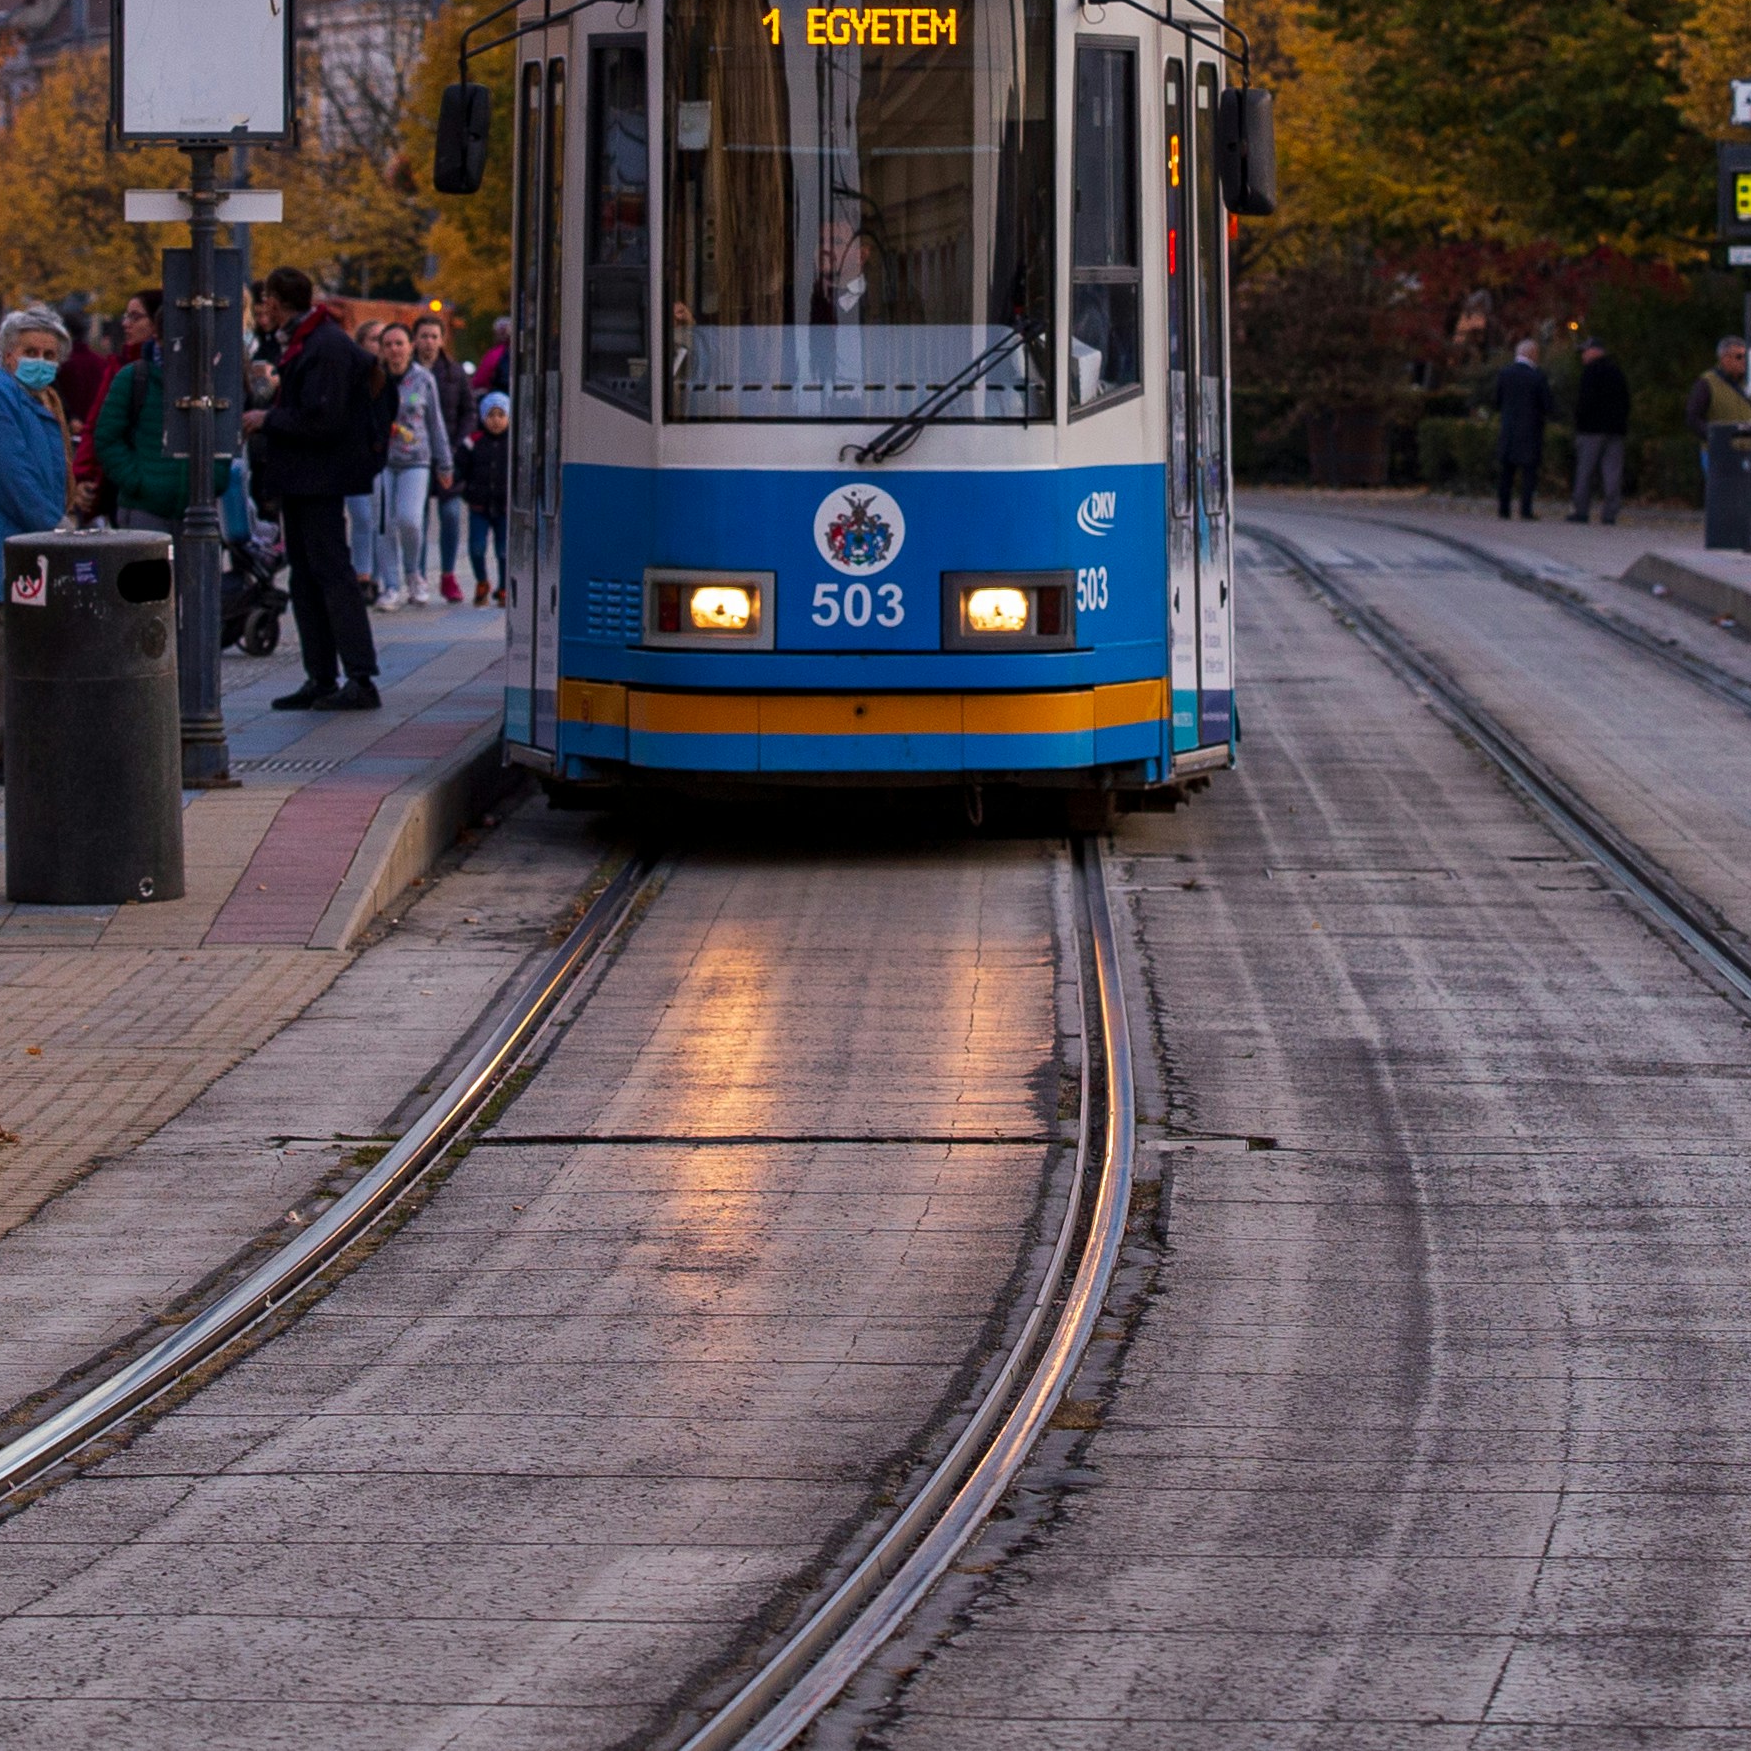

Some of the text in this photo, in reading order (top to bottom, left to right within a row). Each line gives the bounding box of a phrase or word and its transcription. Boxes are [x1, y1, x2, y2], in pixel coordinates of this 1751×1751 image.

[761, 7, 957, 45] 1 EGYETEM
[1091, 491, 1116, 520] DKV
[811, 582, 906, 628] 503
[1077, 566, 1109, 612] 503
